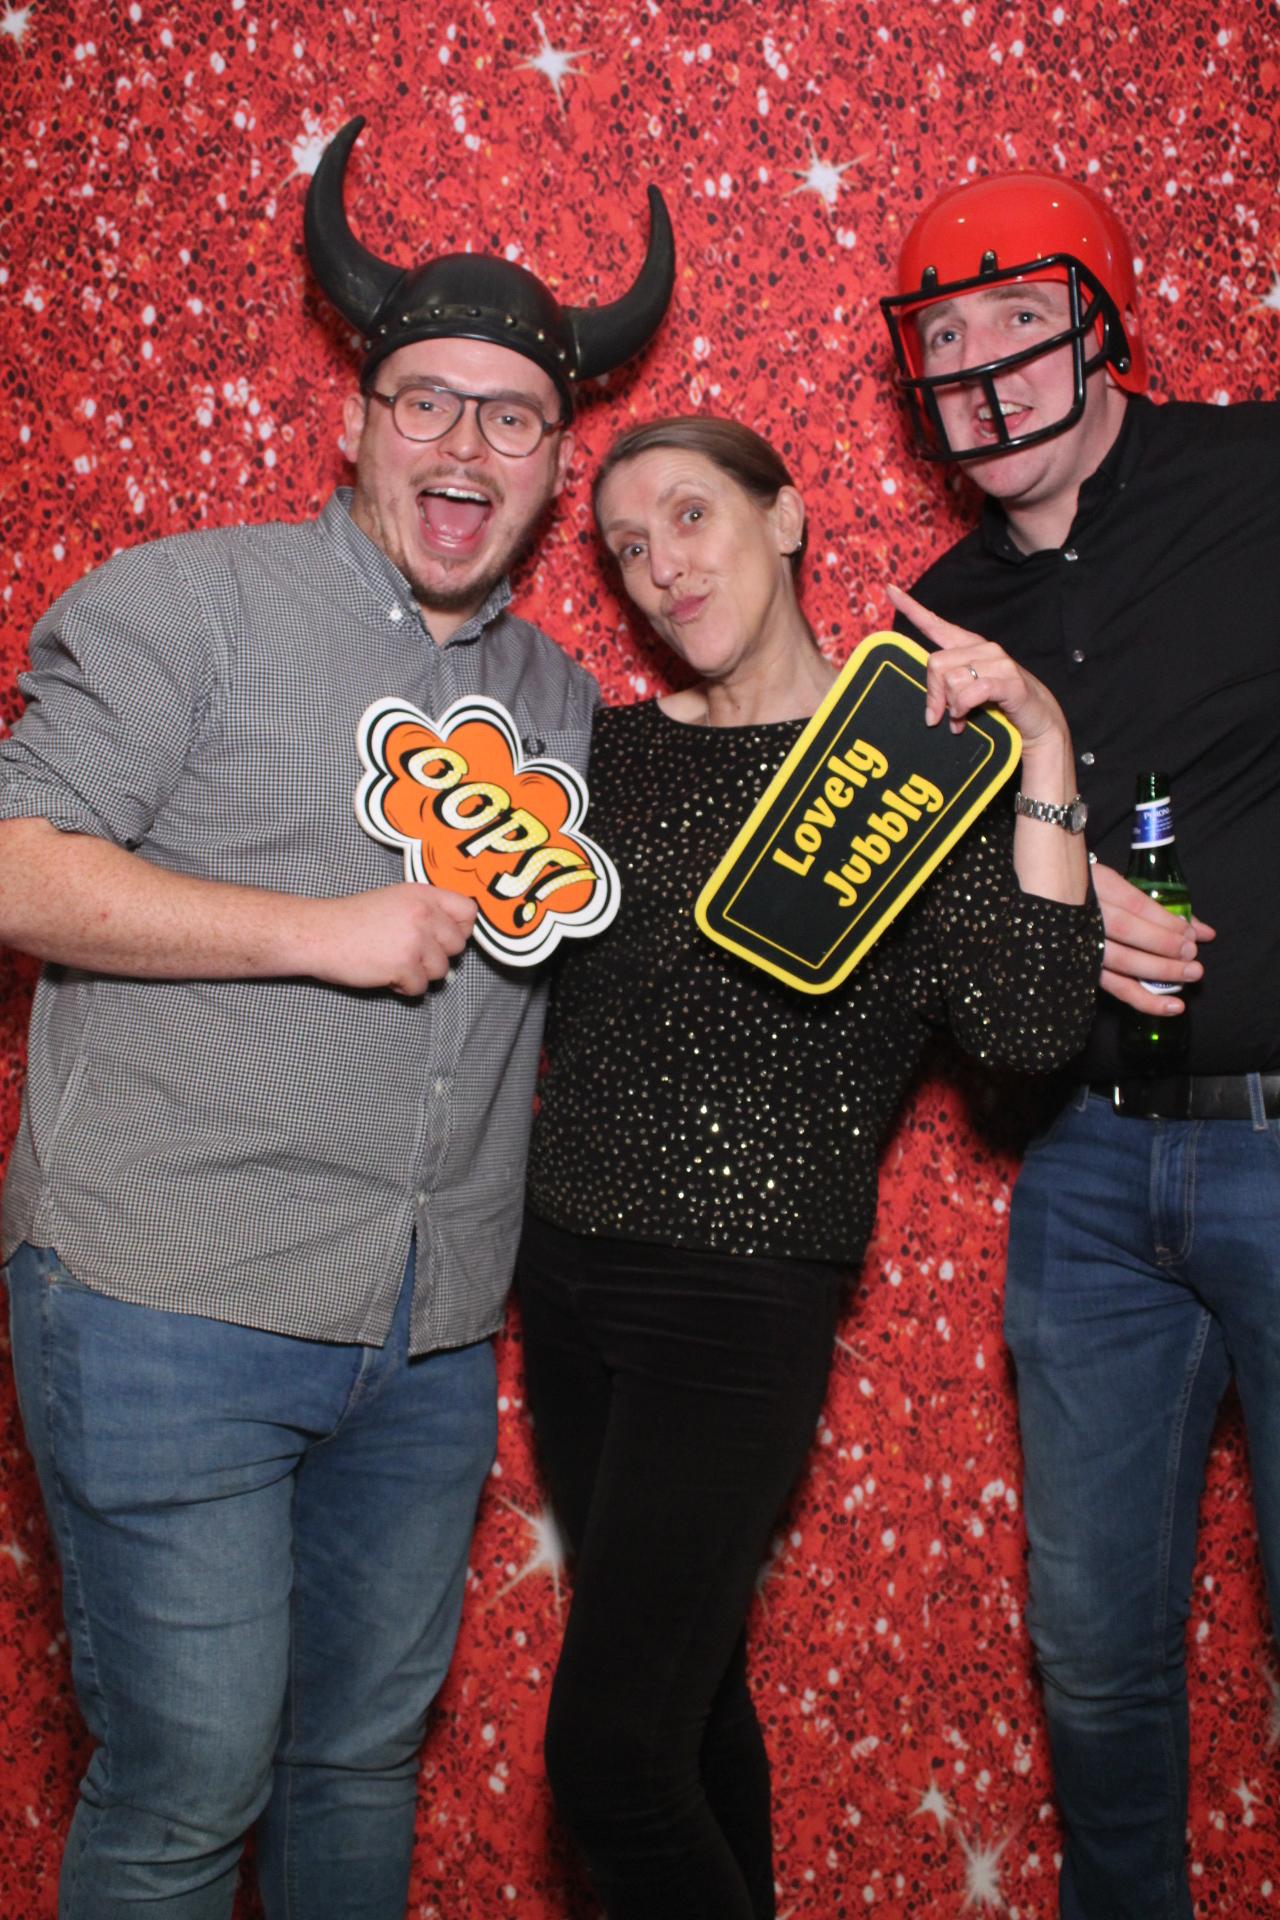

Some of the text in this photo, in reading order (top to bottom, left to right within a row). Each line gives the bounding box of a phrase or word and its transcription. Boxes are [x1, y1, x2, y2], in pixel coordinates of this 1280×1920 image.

[402, 747, 600, 926] OOPS!
[772, 738, 889, 877] Lovely
[823, 773, 944, 908] Jubbly
